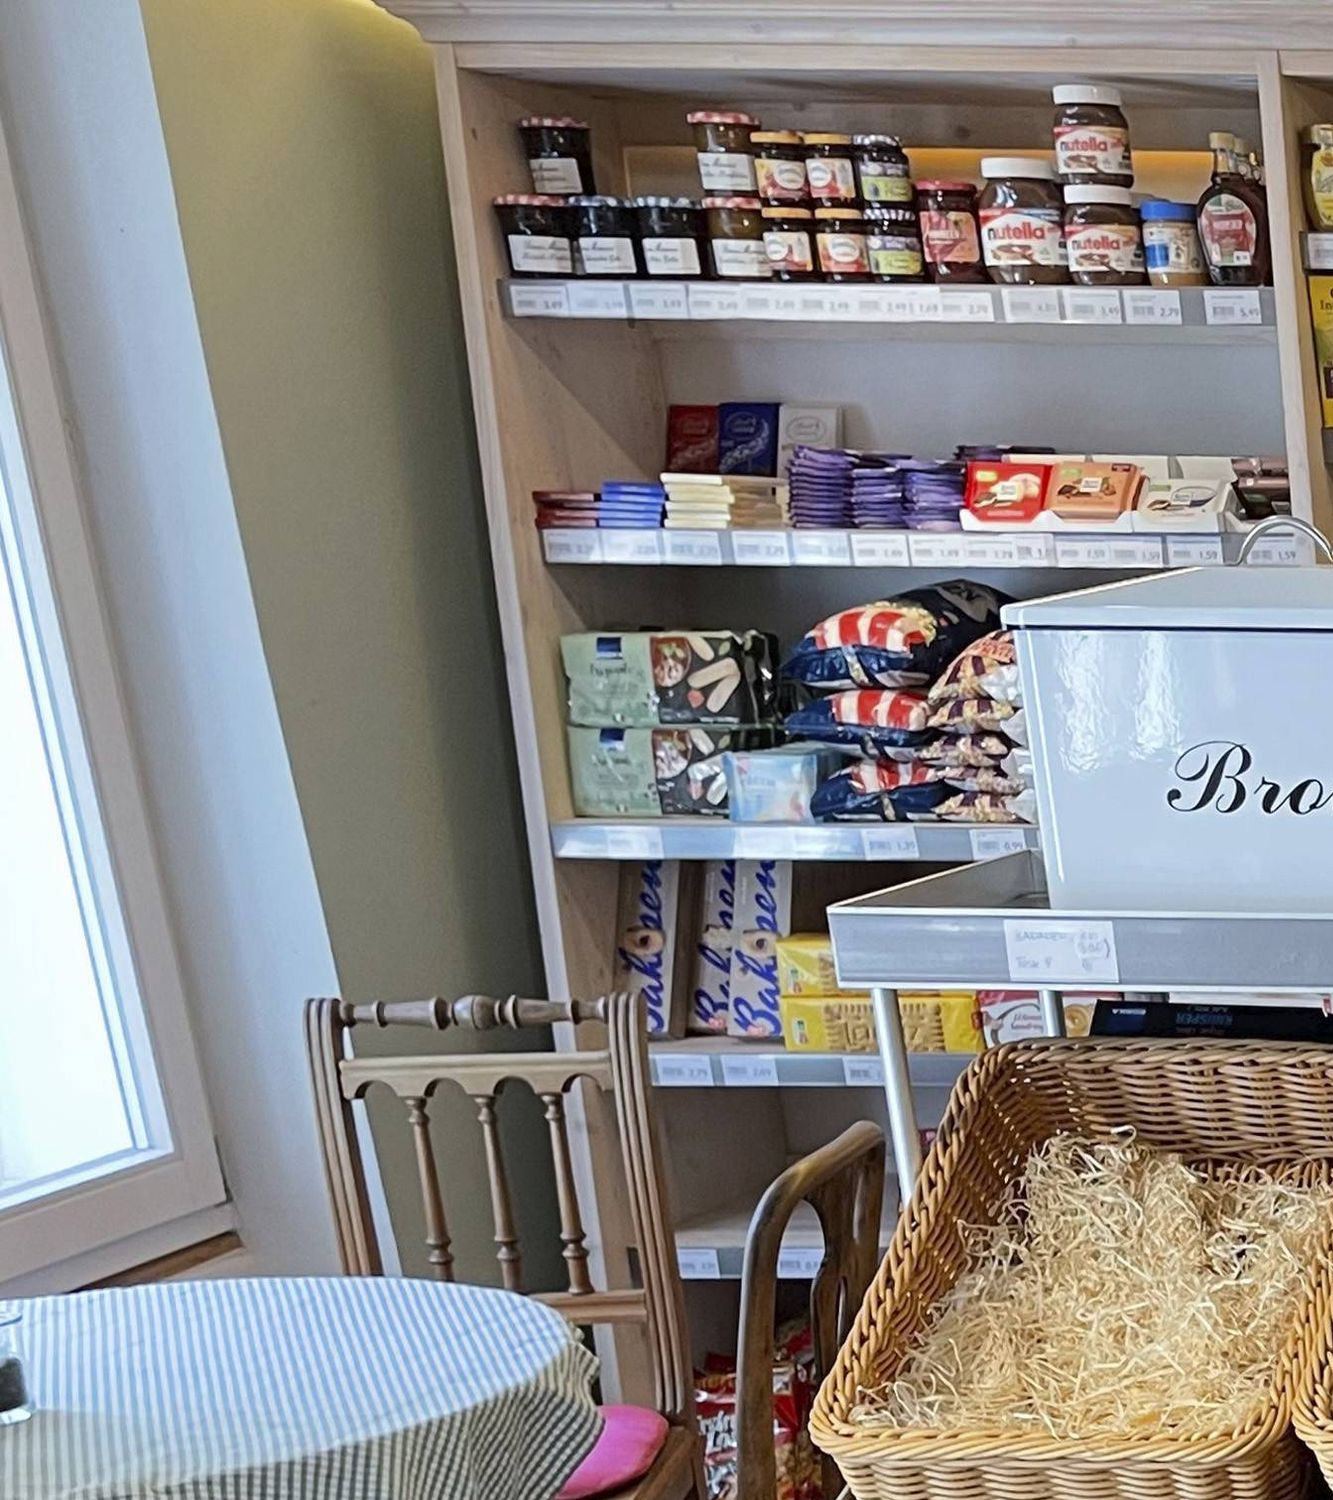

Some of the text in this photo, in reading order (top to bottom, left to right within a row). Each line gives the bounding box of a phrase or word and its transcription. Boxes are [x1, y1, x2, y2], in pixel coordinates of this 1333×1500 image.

[1060, 137, 1107, 152] nutella
[987, 225, 1045, 241] nutella
[1072, 237, 1121, 252] nutella
